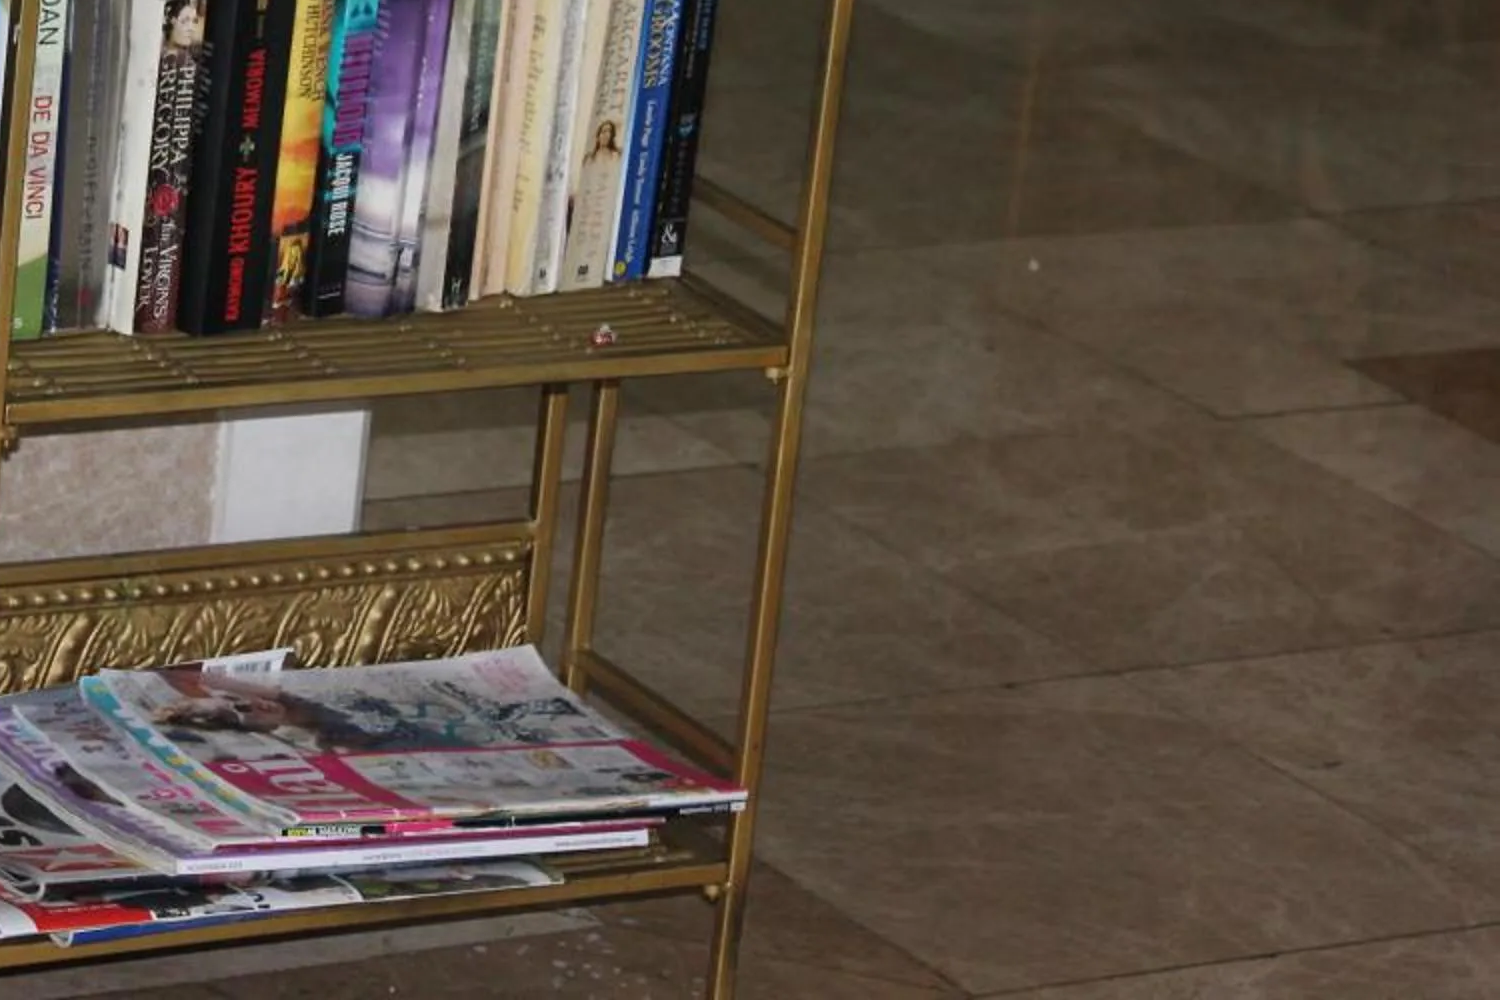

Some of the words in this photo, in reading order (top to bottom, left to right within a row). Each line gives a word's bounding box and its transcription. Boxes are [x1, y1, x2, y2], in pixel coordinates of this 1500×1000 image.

[299, 5, 320, 100] HUTCHINSON
[657, 0, 680, 86] MONTANA
[34, 96, 53, 122] DE
[151, 52, 178, 180] GREGORY
[170, 65, 196, 164] PHILIPPA
[243, 48, 266, 128] MEMORIA
[30, 131, 50, 158] DA
[332, 153, 354, 199] JACQUI
[26, 166, 47, 220] VINCI
[228, 167, 258, 253] KHOURY
[326, 202, 350, 237] ROSE
